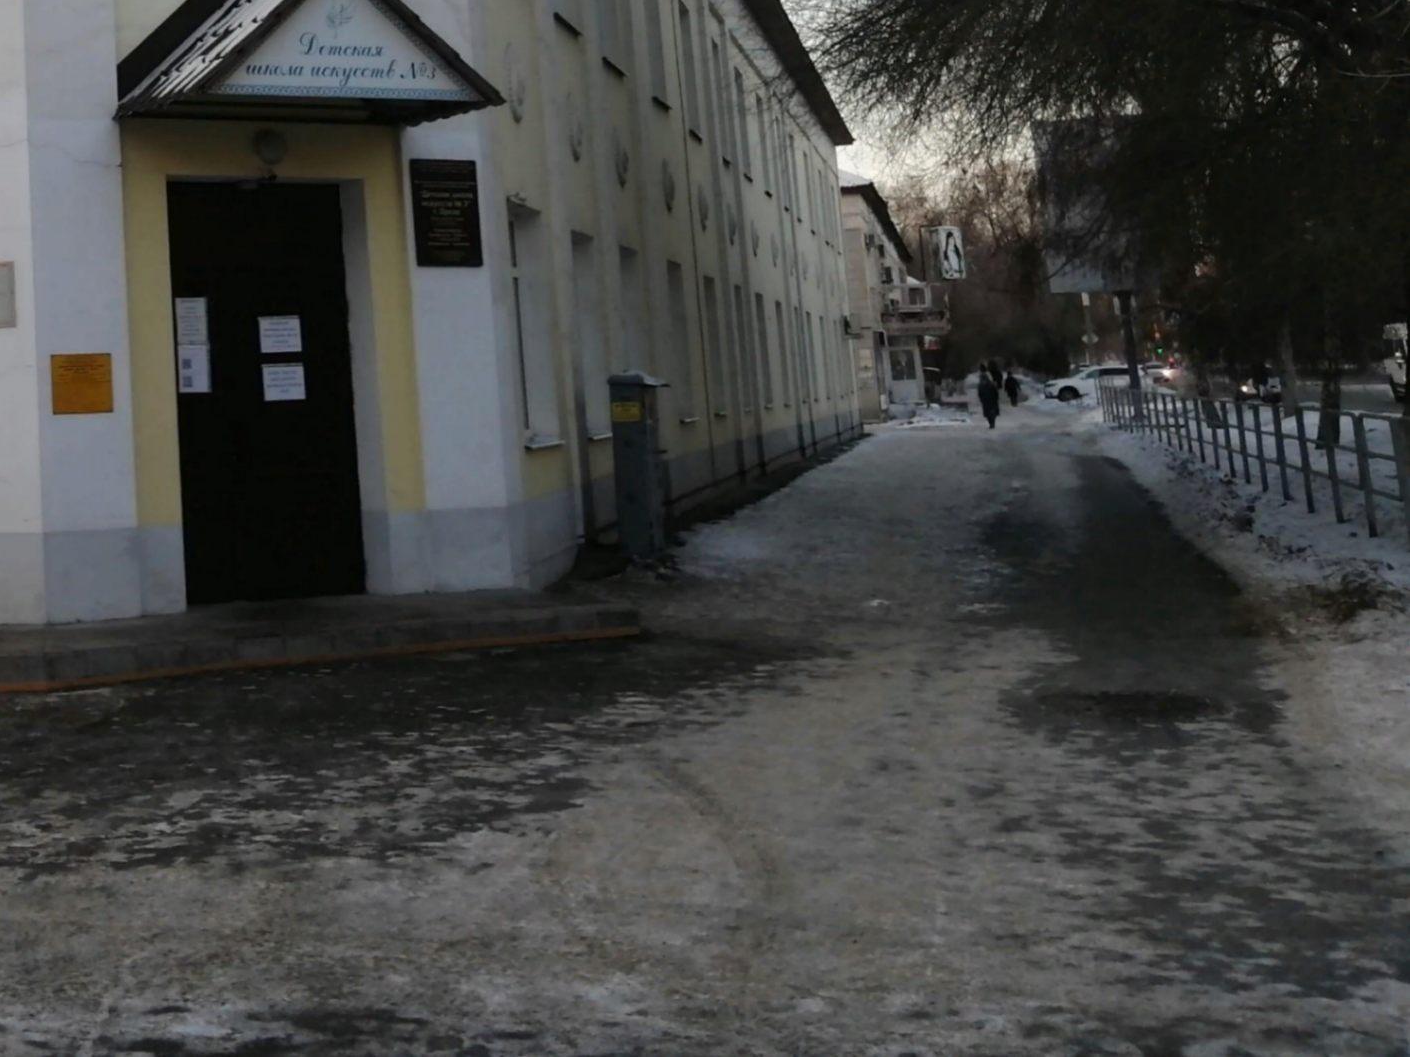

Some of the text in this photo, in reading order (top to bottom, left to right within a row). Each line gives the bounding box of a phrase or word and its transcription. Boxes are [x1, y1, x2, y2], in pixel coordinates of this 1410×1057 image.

[299, 31, 384, 57] Детская
[245, 63, 305, 77] школа
[310, 59, 397, 87] искусств
